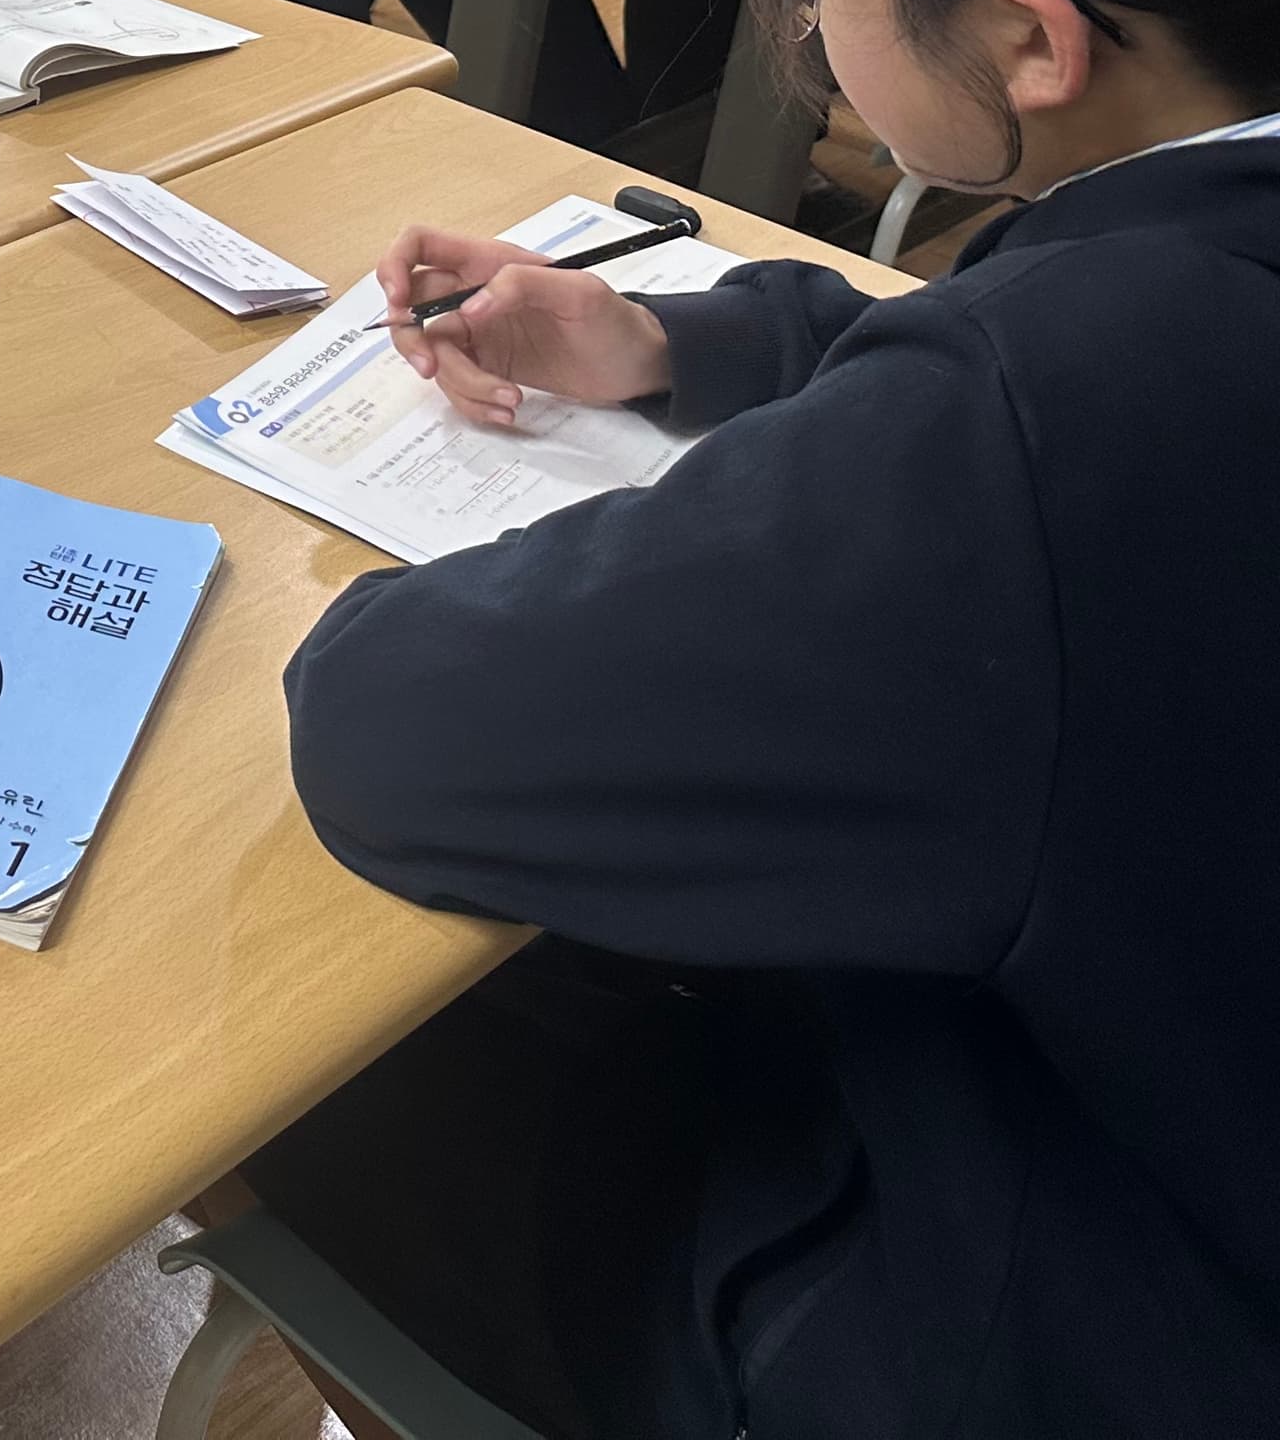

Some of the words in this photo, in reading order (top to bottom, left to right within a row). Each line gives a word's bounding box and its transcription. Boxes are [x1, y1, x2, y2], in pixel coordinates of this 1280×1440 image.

[22, 560, 151, 613] 정답과
[81, 554, 158, 584] LITE
[47, 598, 135, 640] 해설
